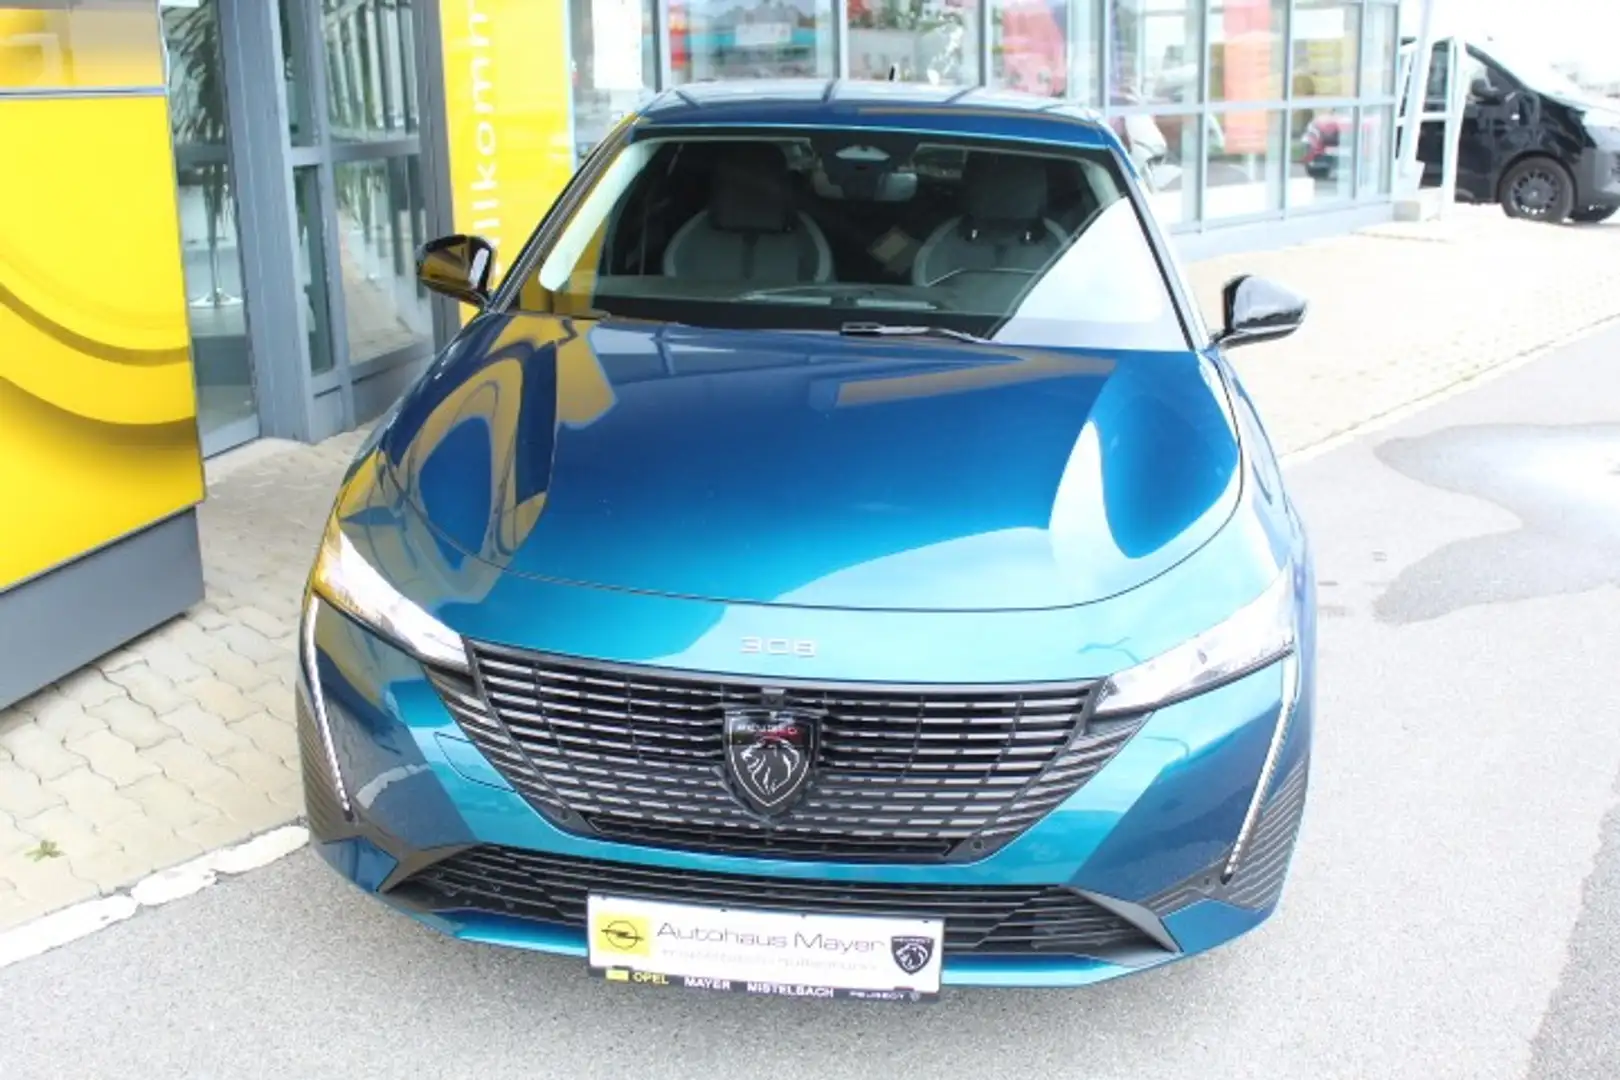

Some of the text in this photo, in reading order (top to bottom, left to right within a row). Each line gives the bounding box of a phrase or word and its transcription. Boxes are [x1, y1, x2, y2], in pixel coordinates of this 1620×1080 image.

[740, 637, 816, 658] 308
[656, 922, 885, 954] Autohaus Mayer
[633, 972, 669, 985] OPEL
[684, 976, 731, 991] MAYER
[747, 981, 834, 998] MISTELBACH
